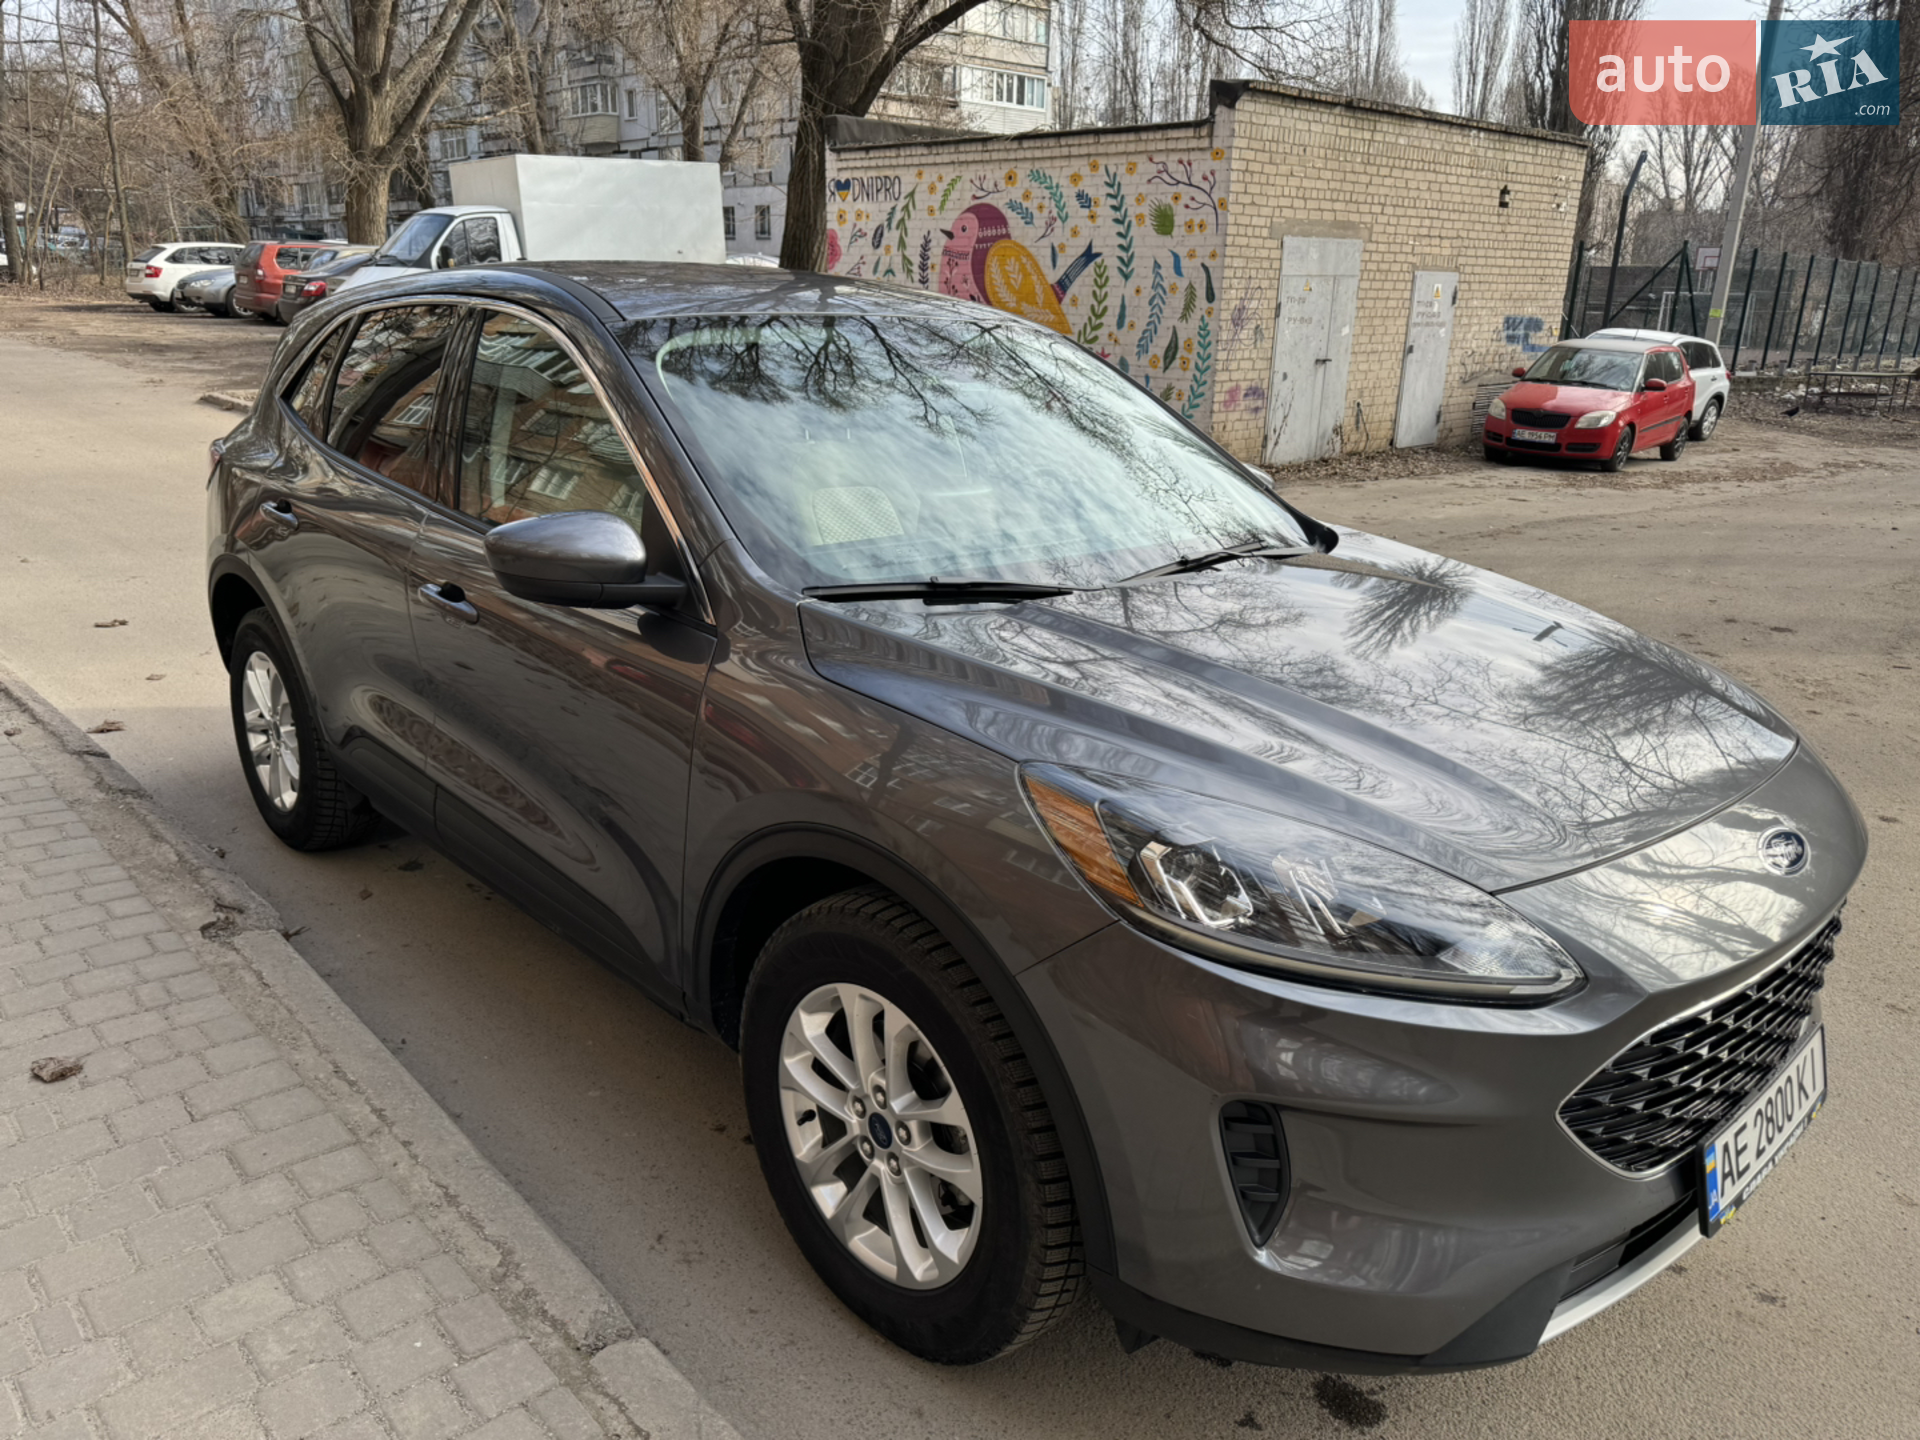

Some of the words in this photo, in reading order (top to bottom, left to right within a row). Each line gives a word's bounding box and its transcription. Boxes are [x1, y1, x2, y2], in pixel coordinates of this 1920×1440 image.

[828, 178, 836, 202] Я
[852, 175, 901, 202] DNIPRO
[1516, 430, 1526, 438] AE
[1720, 1122, 1750, 1198] AE
[1753, 1075, 1794, 1160] 2800
[1796, 1047, 1816, 1110] KI
